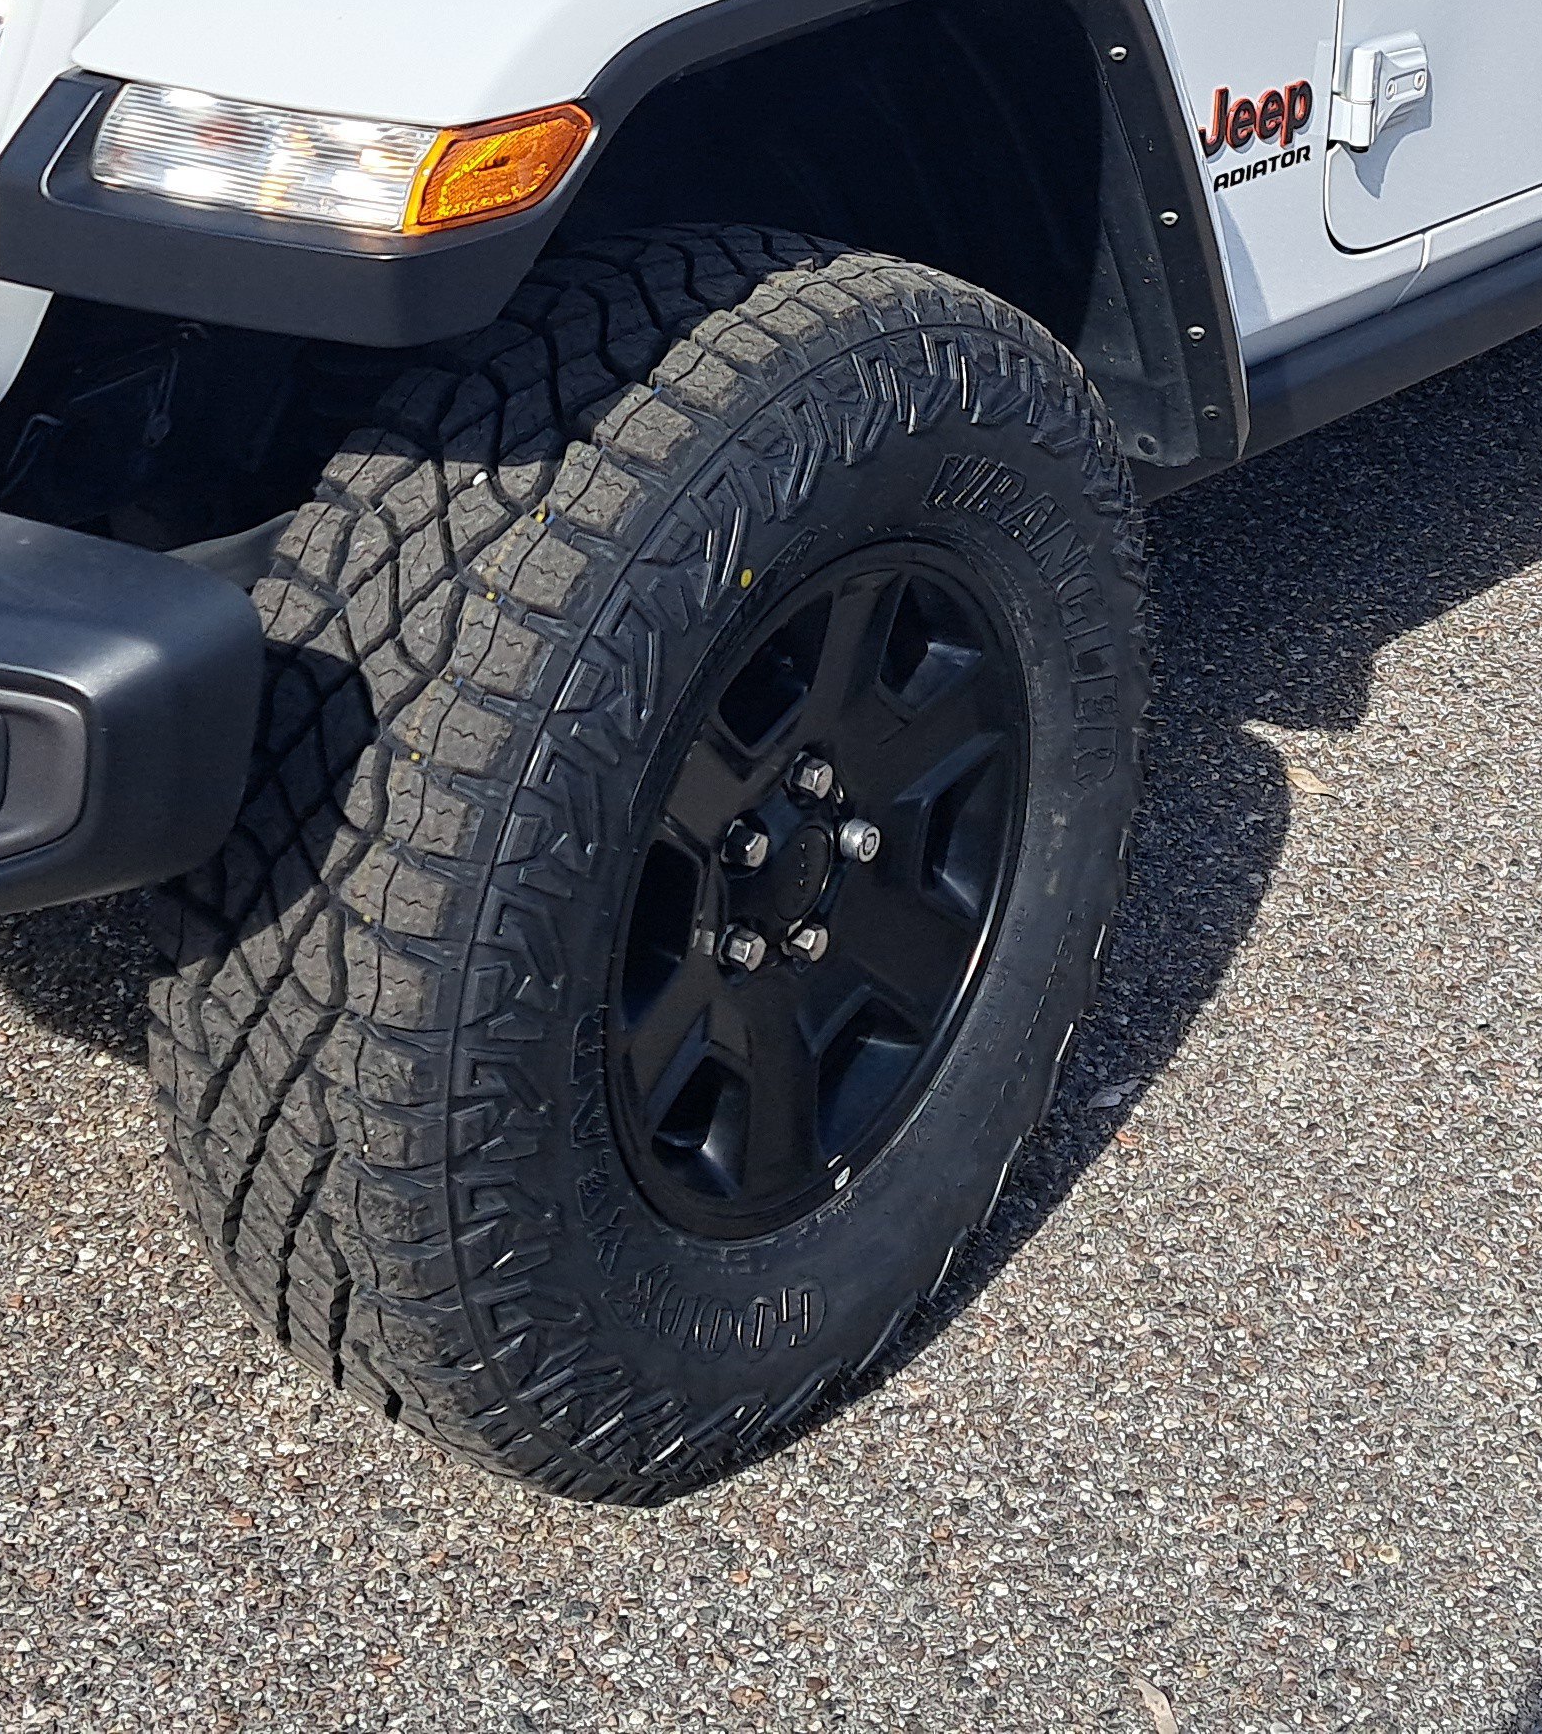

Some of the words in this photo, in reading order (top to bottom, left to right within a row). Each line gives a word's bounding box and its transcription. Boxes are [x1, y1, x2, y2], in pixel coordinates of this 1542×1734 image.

[1198, 80, 1313, 159] Jeep
[1213, 144, 1311, 193] ADIATOR
[922, 453, 1121, 788] WRANGLER
